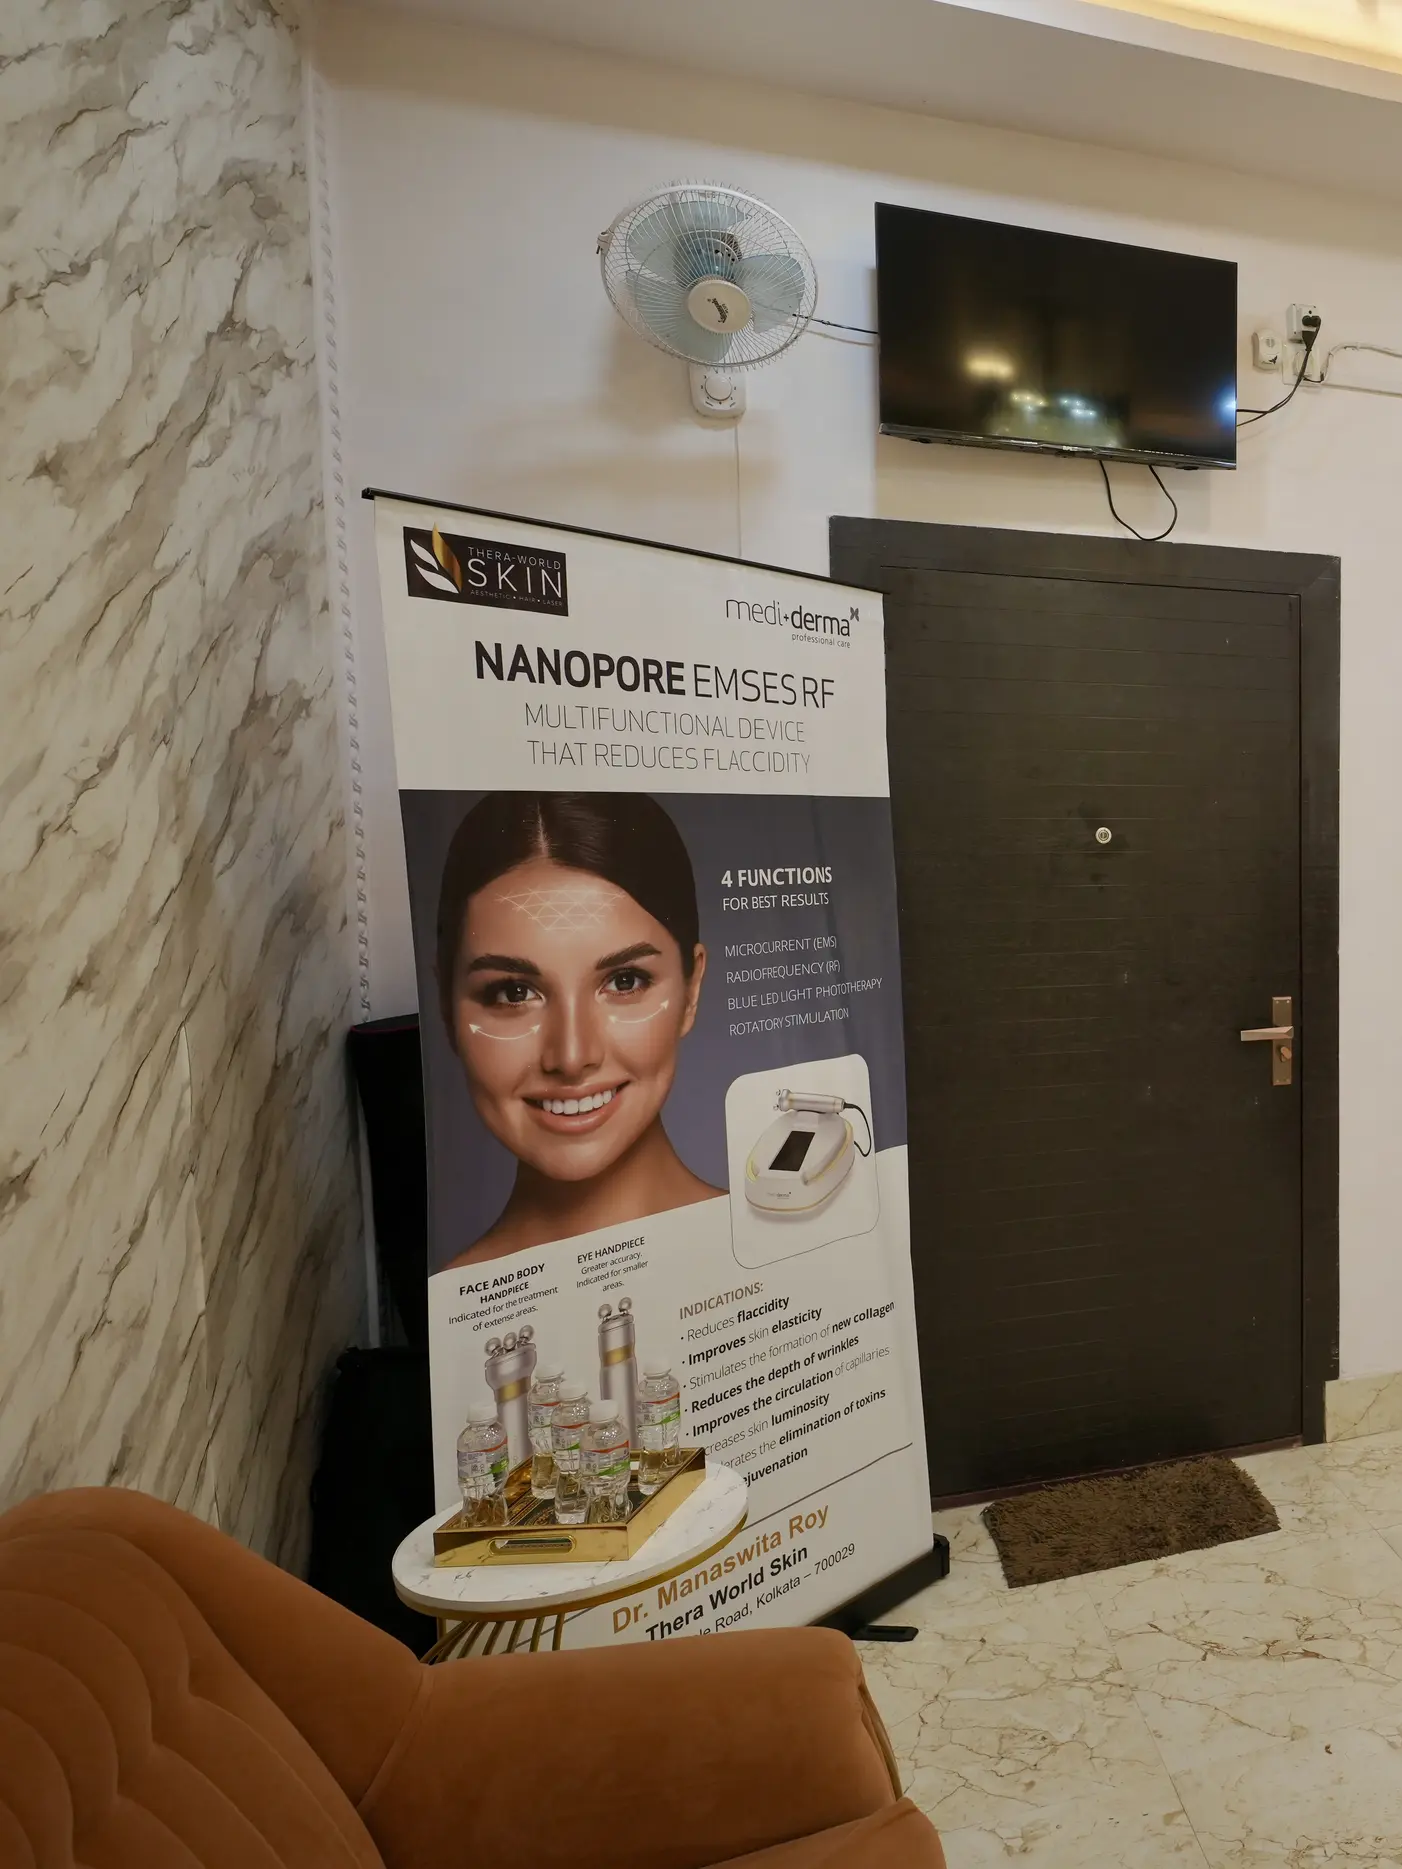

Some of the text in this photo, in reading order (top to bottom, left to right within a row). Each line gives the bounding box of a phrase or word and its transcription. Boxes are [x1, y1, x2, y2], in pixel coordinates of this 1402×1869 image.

[468, 546, 561, 570] THERA-WORLD
[468, 558, 562, 598] SKIN
[470, 589, 510, 599] AESTHETIC
[543, 599, 563, 607] LASER
[791, 633, 851, 649] professional care
[474, 640, 835, 709] NANOPORE EMSES RF
[525, 702, 805, 743] MULTIFUNCTIONAL DEVICE
[527, 740, 810, 774] THAT REDUCES FLACCIDITY
[721, 866, 833, 888] 4 FUNCTIONS
[723, 892, 829, 911] FOR BEST RESULTS
[725, 936, 837, 957] MICROCURRENT (EMS)
[726, 960, 841, 984] RADIOFREQUENCY (RF)
[728, 978, 883, 1010] BLUE LED LIGHT PHOTOTHERAPY
[729, 1008, 849, 1036] ROTATORY STIMULATION
[577, 1236, 645, 1264] EYE HANDPIECE
[581, 1251, 642, 1275] Greater accuracy.
[459, 1263, 545, 1296] FACE AND BODY
[576, 1260, 648, 1288] Indicated for smaller
[602, 1280, 625, 1292] areas.
[448, 1286, 559, 1325] Indicated for the treatment
[480, 1281, 529, 1304] HANDPIECE
[679, 1281, 764, 1320] INDICATIONS:
[472, 1304, 539, 1332] of extense areas.
[687, 1296, 790, 1342] Reduces flaccidity
[688, 1306, 823, 1366] Improves skin elasticity
[689, 1300, 895, 1390] Stimulates the formation of new collagen
[691, 1385, 743, 1414] Reduces
[745, 1375, 765, 1391] the
[768, 1359, 801, 1383] depth
[803, 1352, 816, 1367] of
[817, 1334, 859, 1361] wrinkles
[692, 1405, 750, 1438] Improves
[752, 1395, 773, 1411] the
[774, 1368, 833, 1402] circulation
[834, 1363, 845, 1377] of
[845, 1346, 890, 1373] capillaries
[705, 1392, 830, 1456] creases skin luminosity
[759, 1440, 777, 1455] the
[779, 1411, 841, 1446] elimination
[843, 1403, 855, 1417] of
[855, 1388, 886, 1409] toxins
[612, 1505, 829, 1634] Dr. Manaswita Roy
[645, 1545, 808, 1642] Thera World Skin
[715, 1603, 753, 1632] Road,
[756, 1576, 800, 1608] Kolkata
[814, 1543, 855, 1574] 700029
